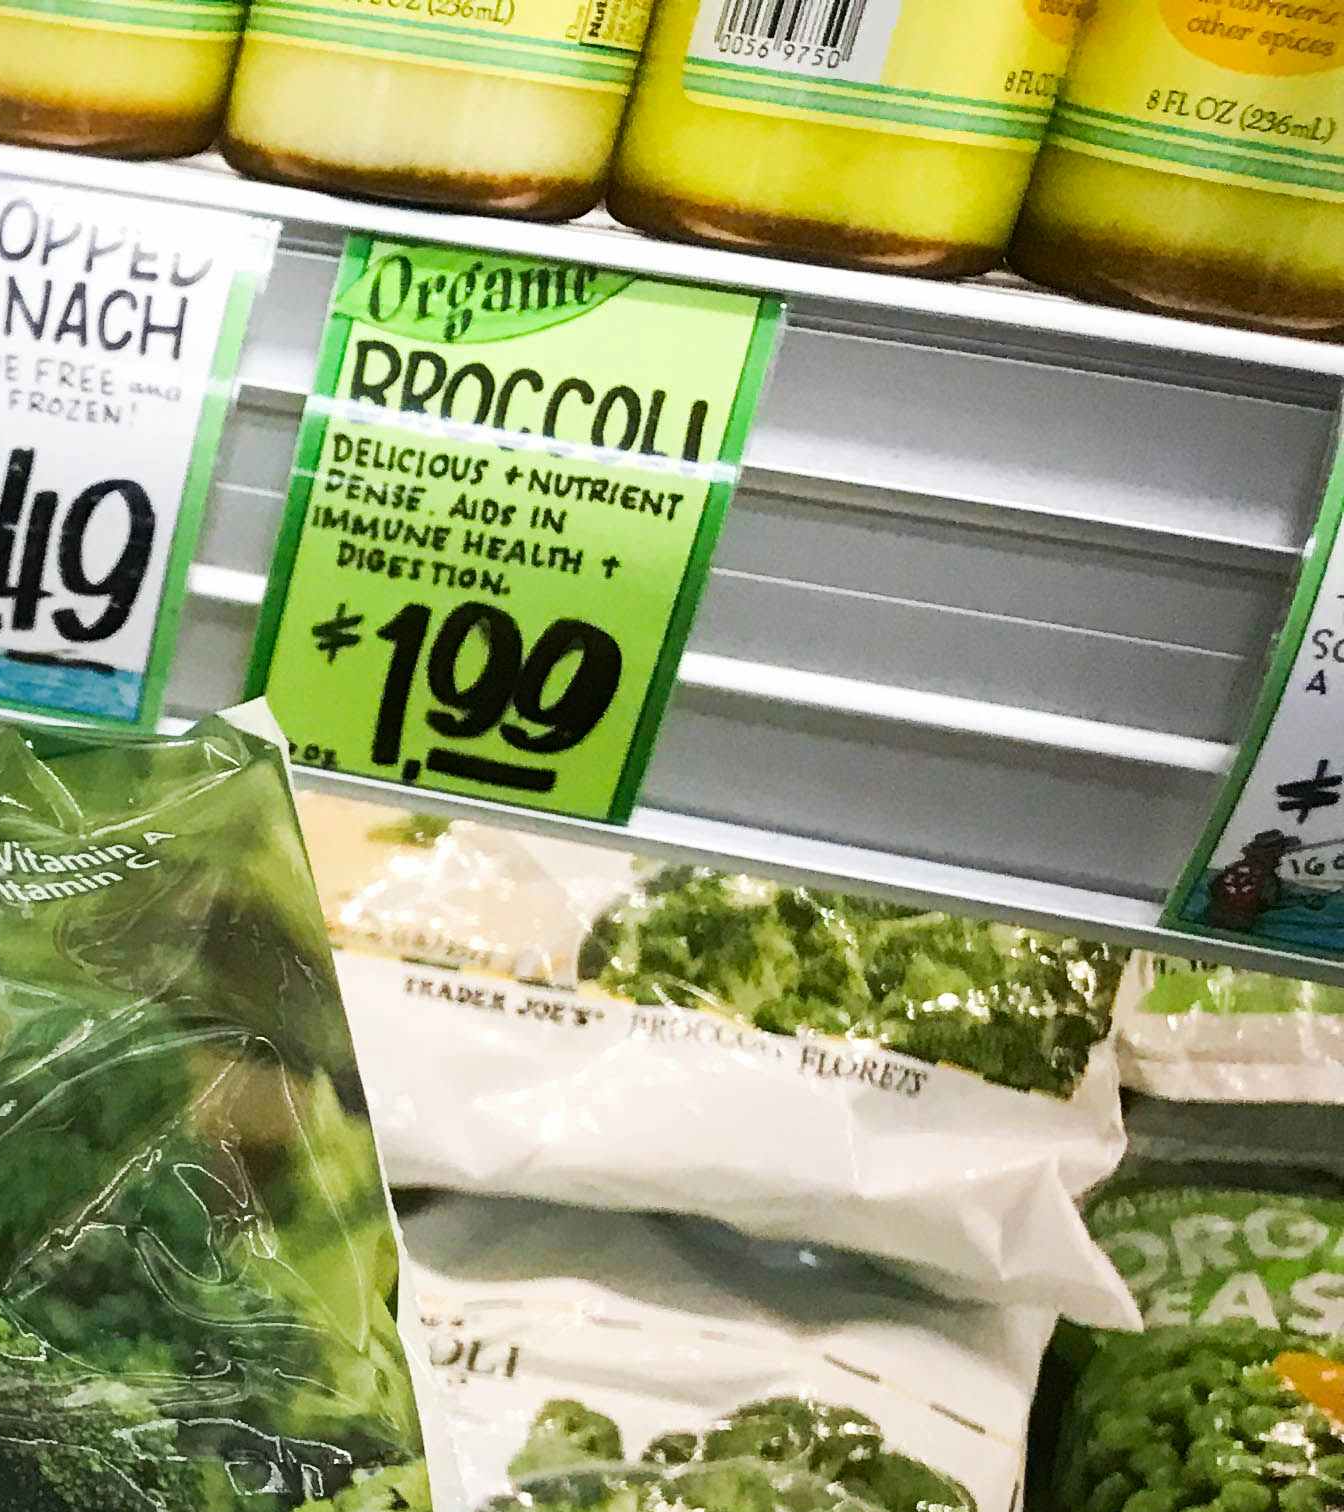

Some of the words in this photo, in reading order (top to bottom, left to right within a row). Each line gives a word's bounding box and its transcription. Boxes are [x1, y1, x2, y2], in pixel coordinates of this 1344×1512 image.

[1145, 88, 1161, 112] 8
[1194, 96, 1238, 125] OZ
[34, 357, 114, 396] FREE
[9, 389, 138, 426] FROZEN!
[332, 433, 489, 481] DELICIOUS
[449, 495, 517, 528] AIDS
[531, 506, 568, 536] IN
[313, 507, 451, 553] IMMUNE
[463, 530, 584, 576] HEALTH
